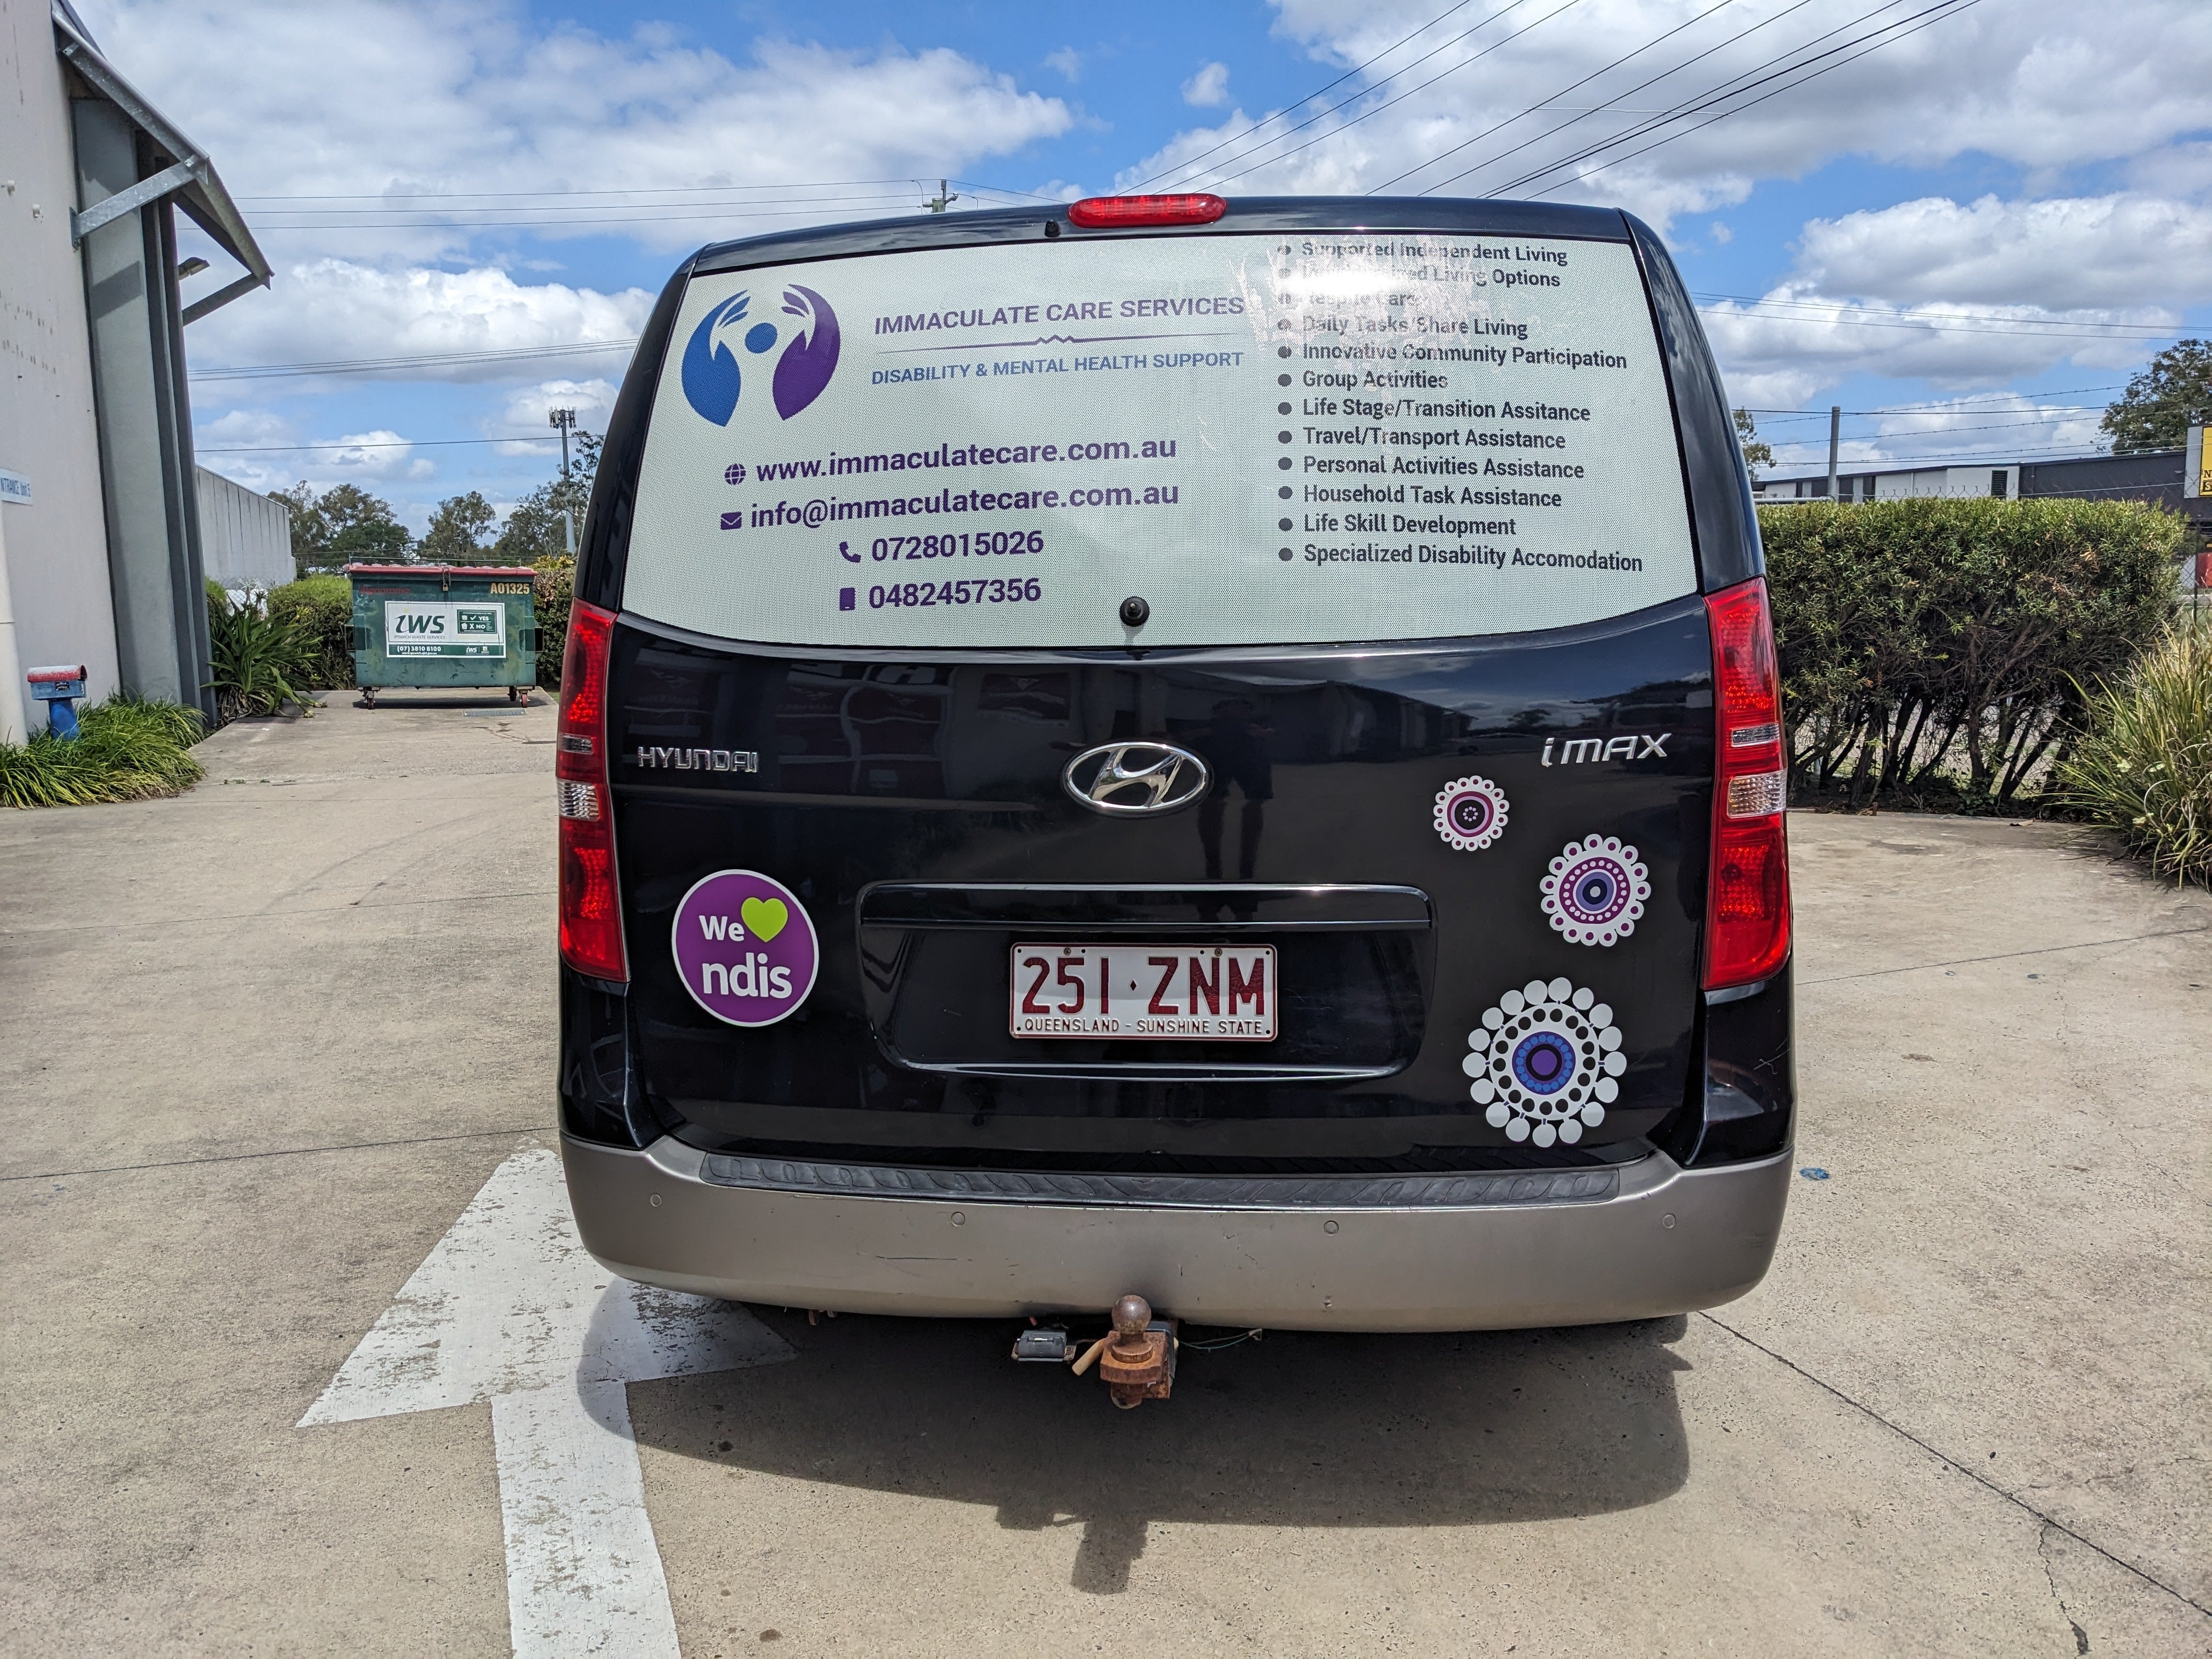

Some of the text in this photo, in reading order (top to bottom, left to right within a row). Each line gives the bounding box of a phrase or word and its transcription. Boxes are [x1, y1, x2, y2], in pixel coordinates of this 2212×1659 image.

[1302, 242, 1568, 267] Supported Independent Living
[1434, 266, 1487, 286] Living
[1493, 269, 1560, 288] Options
[875, 297, 1244, 334] IMMACULATE CARE SERVICES
[1303, 314, 1349, 336] Daily
[1474, 318, 1528, 340] Living
[872, 352, 1244, 385] DISABILITY & MENTAL HEALTH SUPPORT
[1303, 343, 1627, 369] Innovative Community Participation
[1303, 371, 1448, 391] Group Activities
[1303, 399, 1590, 421] Life Stage/Transition Assitance
[1304, 427, 1566, 449] Travel/Transport Assistance
[757, 438, 1176, 481] www.immaculatecare.com.au
[1304, 456, 1584, 478] Personal Activities Assistance
[751, 484, 1178, 529] info@immaculatecare.com.au
[1304, 484, 1561, 507] Household Task Assistance
[1304, 513, 1516, 538] Life Skill Development
[872, 531, 1044, 562] 0728015026
[1304, 543, 1643, 572] Specialized Disability Accomodation
[490, 583, 530, 594] A01325
[869, 578, 1042, 610] 0482457356
[638, 747, 758, 773] HYUNDAI
[699, 915, 744, 941] We
[702, 952, 792, 998] ndis
[1023, 957, 1265, 1015] 251 ZNM
[1025, 1018, 1120, 1032] QUEENSLAND
[1137, 1019, 1210, 1034] SUNSHINE
[1218, 1020, 1262, 1034] STATE
